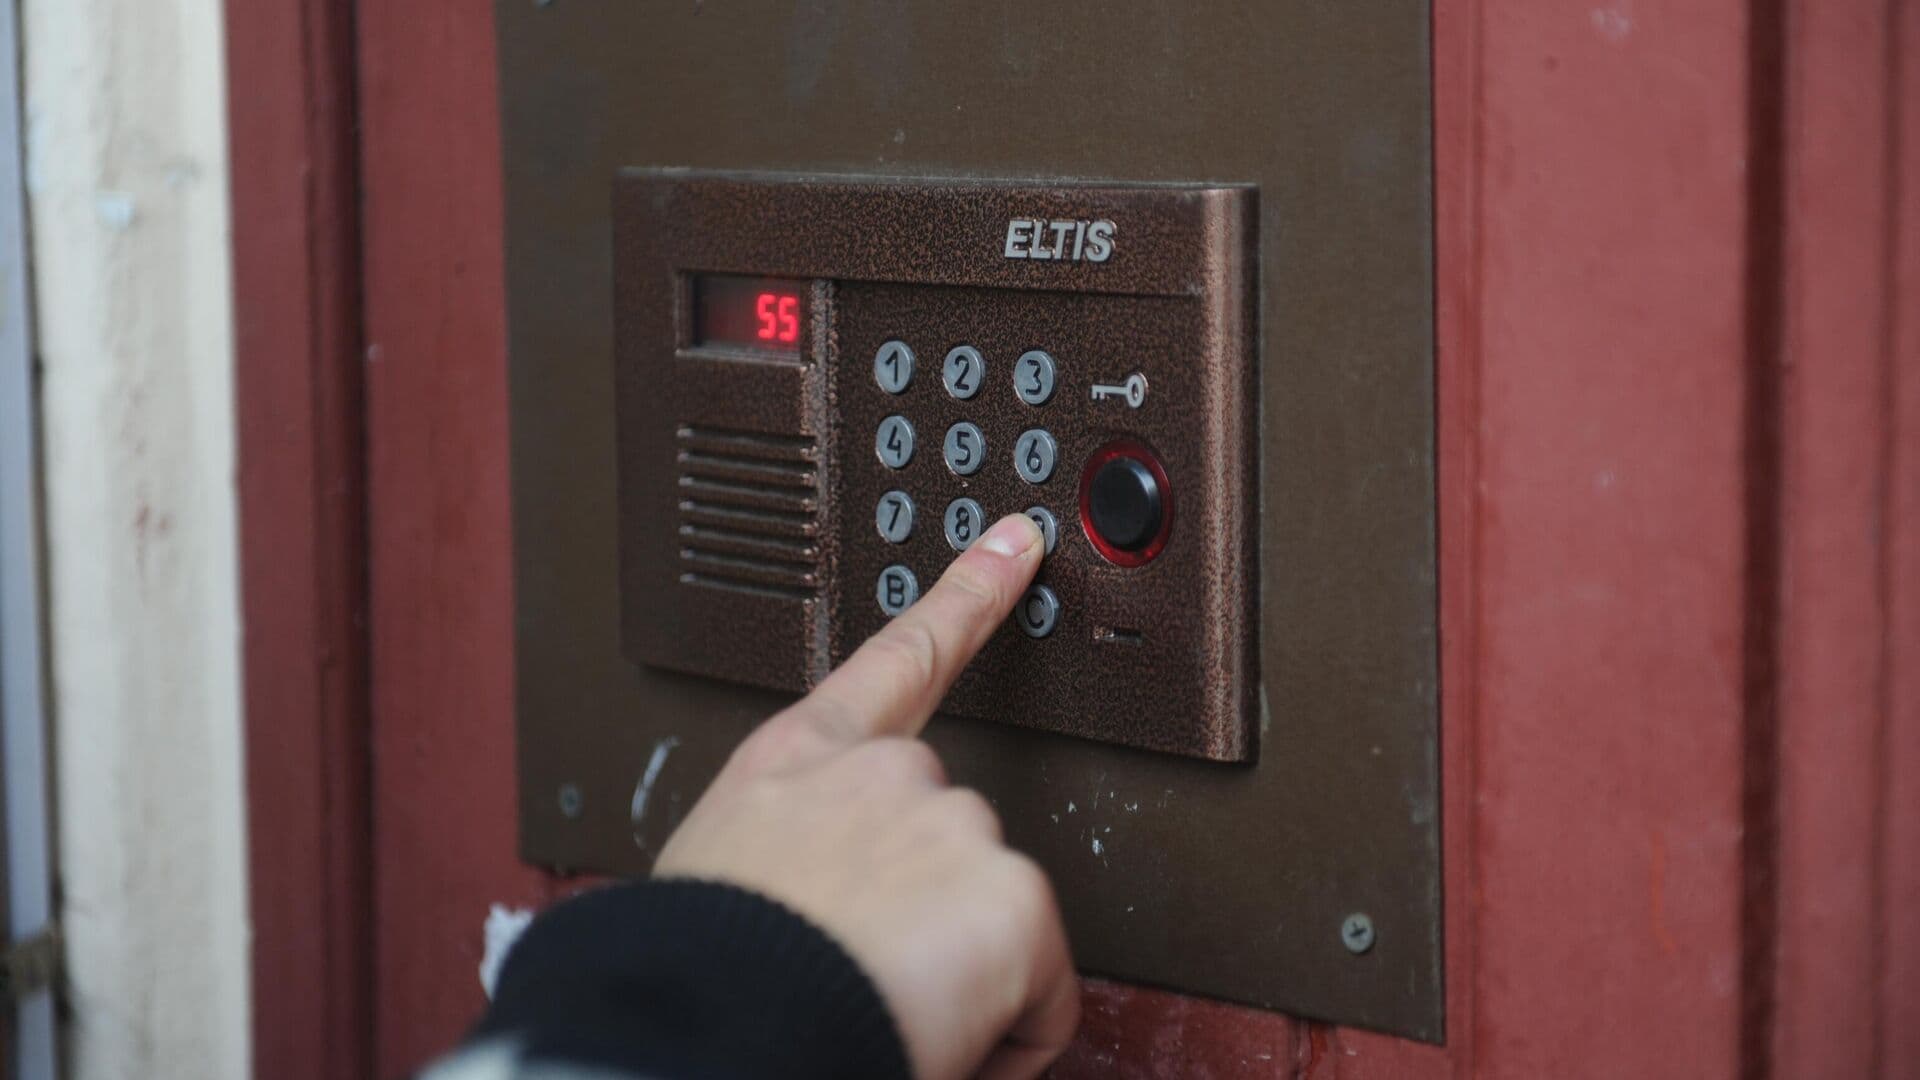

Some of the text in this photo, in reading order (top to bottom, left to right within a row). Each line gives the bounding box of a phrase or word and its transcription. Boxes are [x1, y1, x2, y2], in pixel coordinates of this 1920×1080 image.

[1004, 218, 1116, 262] ELTIS
[757, 293, 798, 342] 55
[885, 350, 899, 386] 1
[954, 354, 970, 391] 2
[1025, 359, 1042, 395] 3
[886, 424, 901, 461] 4
[954, 430, 971, 466] 5
[1026, 438, 1043, 474] 6
[886, 500, 901, 532] 7
[955, 506, 970, 542] 8
[886, 573, 905, 609] B
[1025, 594, 1045, 629] C
